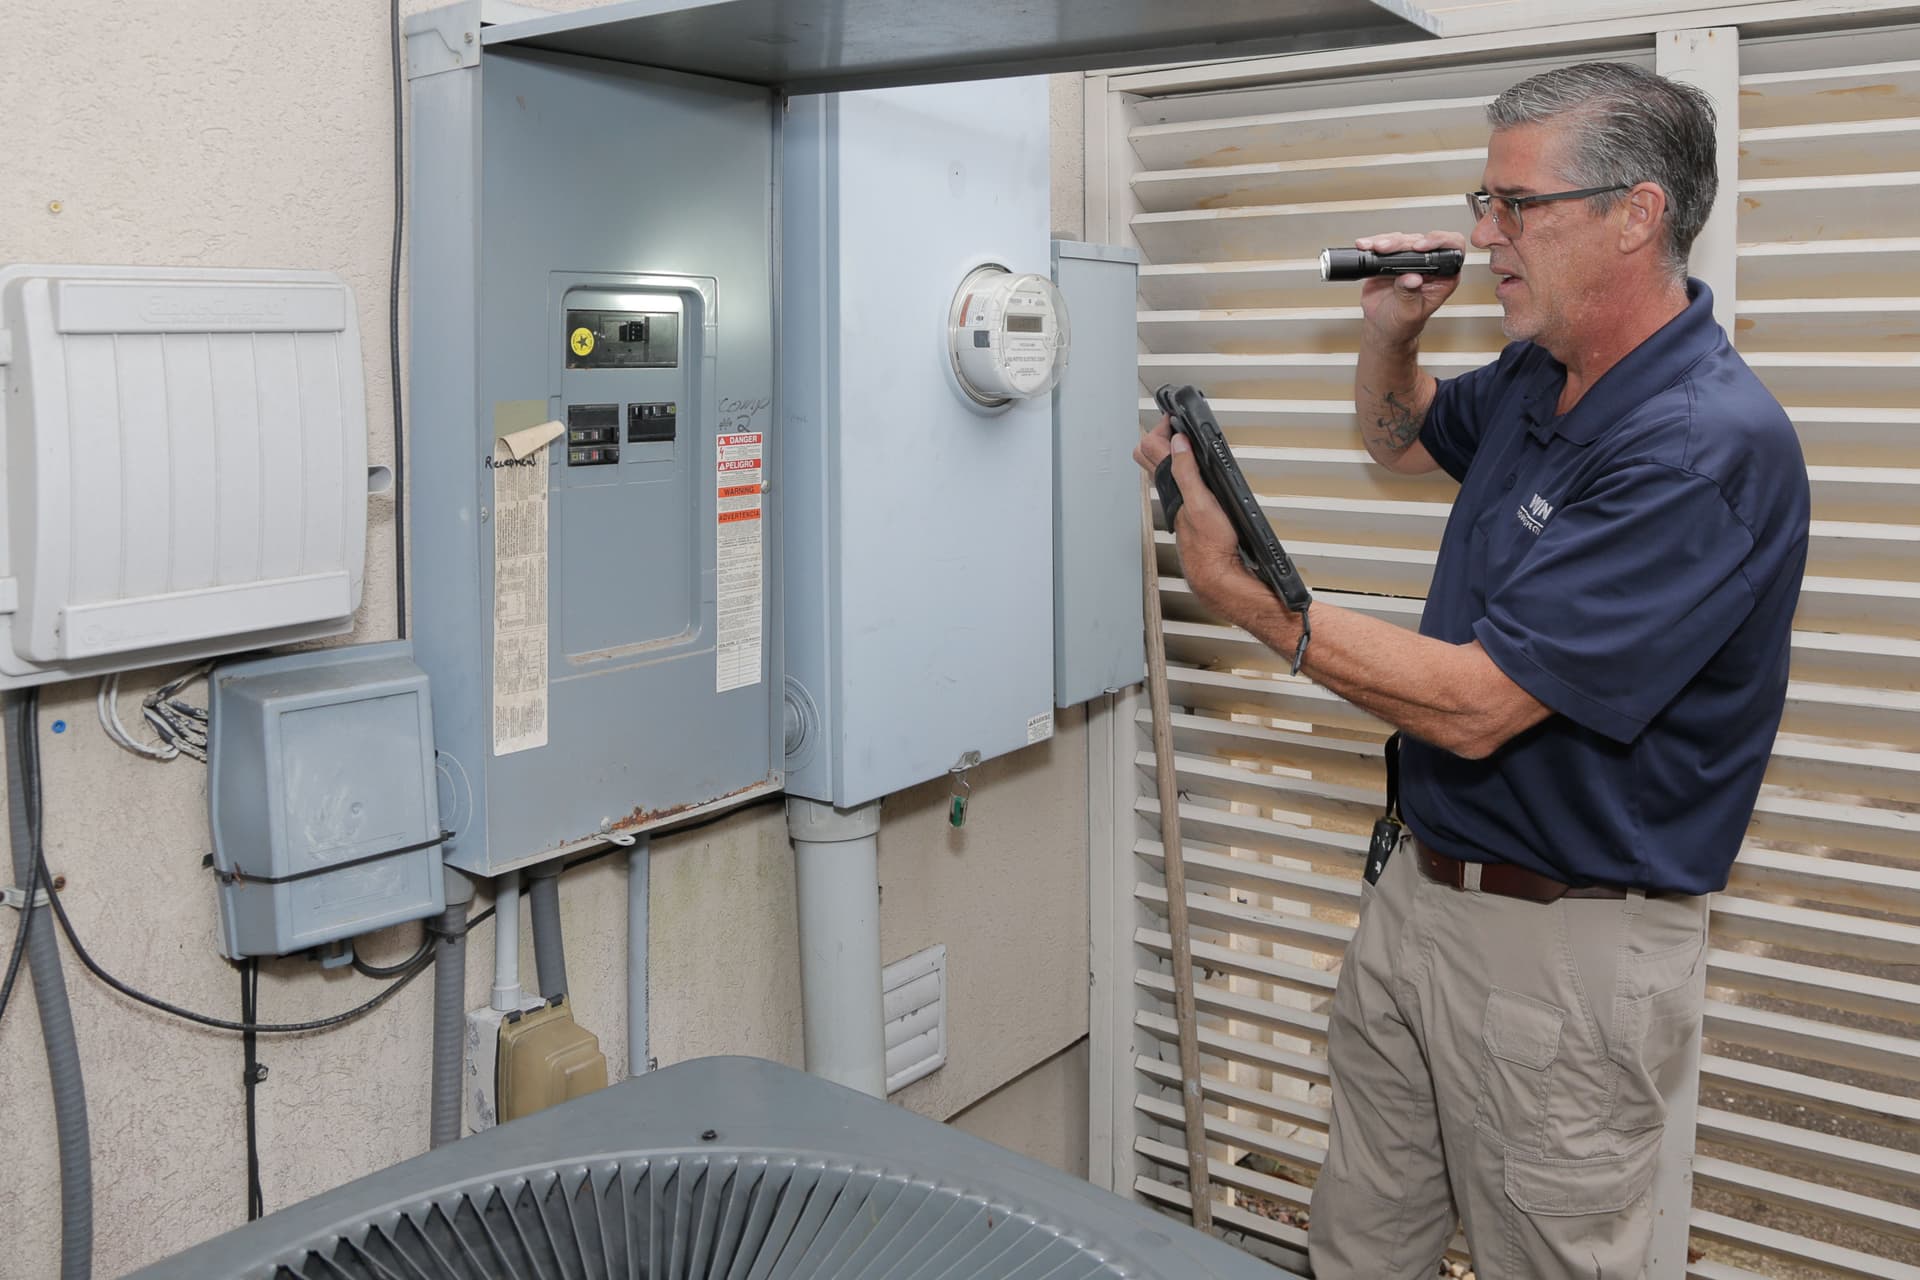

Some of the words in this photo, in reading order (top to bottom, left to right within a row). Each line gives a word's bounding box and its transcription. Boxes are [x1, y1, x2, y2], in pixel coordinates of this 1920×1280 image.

[729, 435, 758, 444] DANGER
[725, 460, 754, 469] PELIGRO
[723, 485, 754, 496] WARNING
[719, 510, 760, 521] ADVERTENCIA
